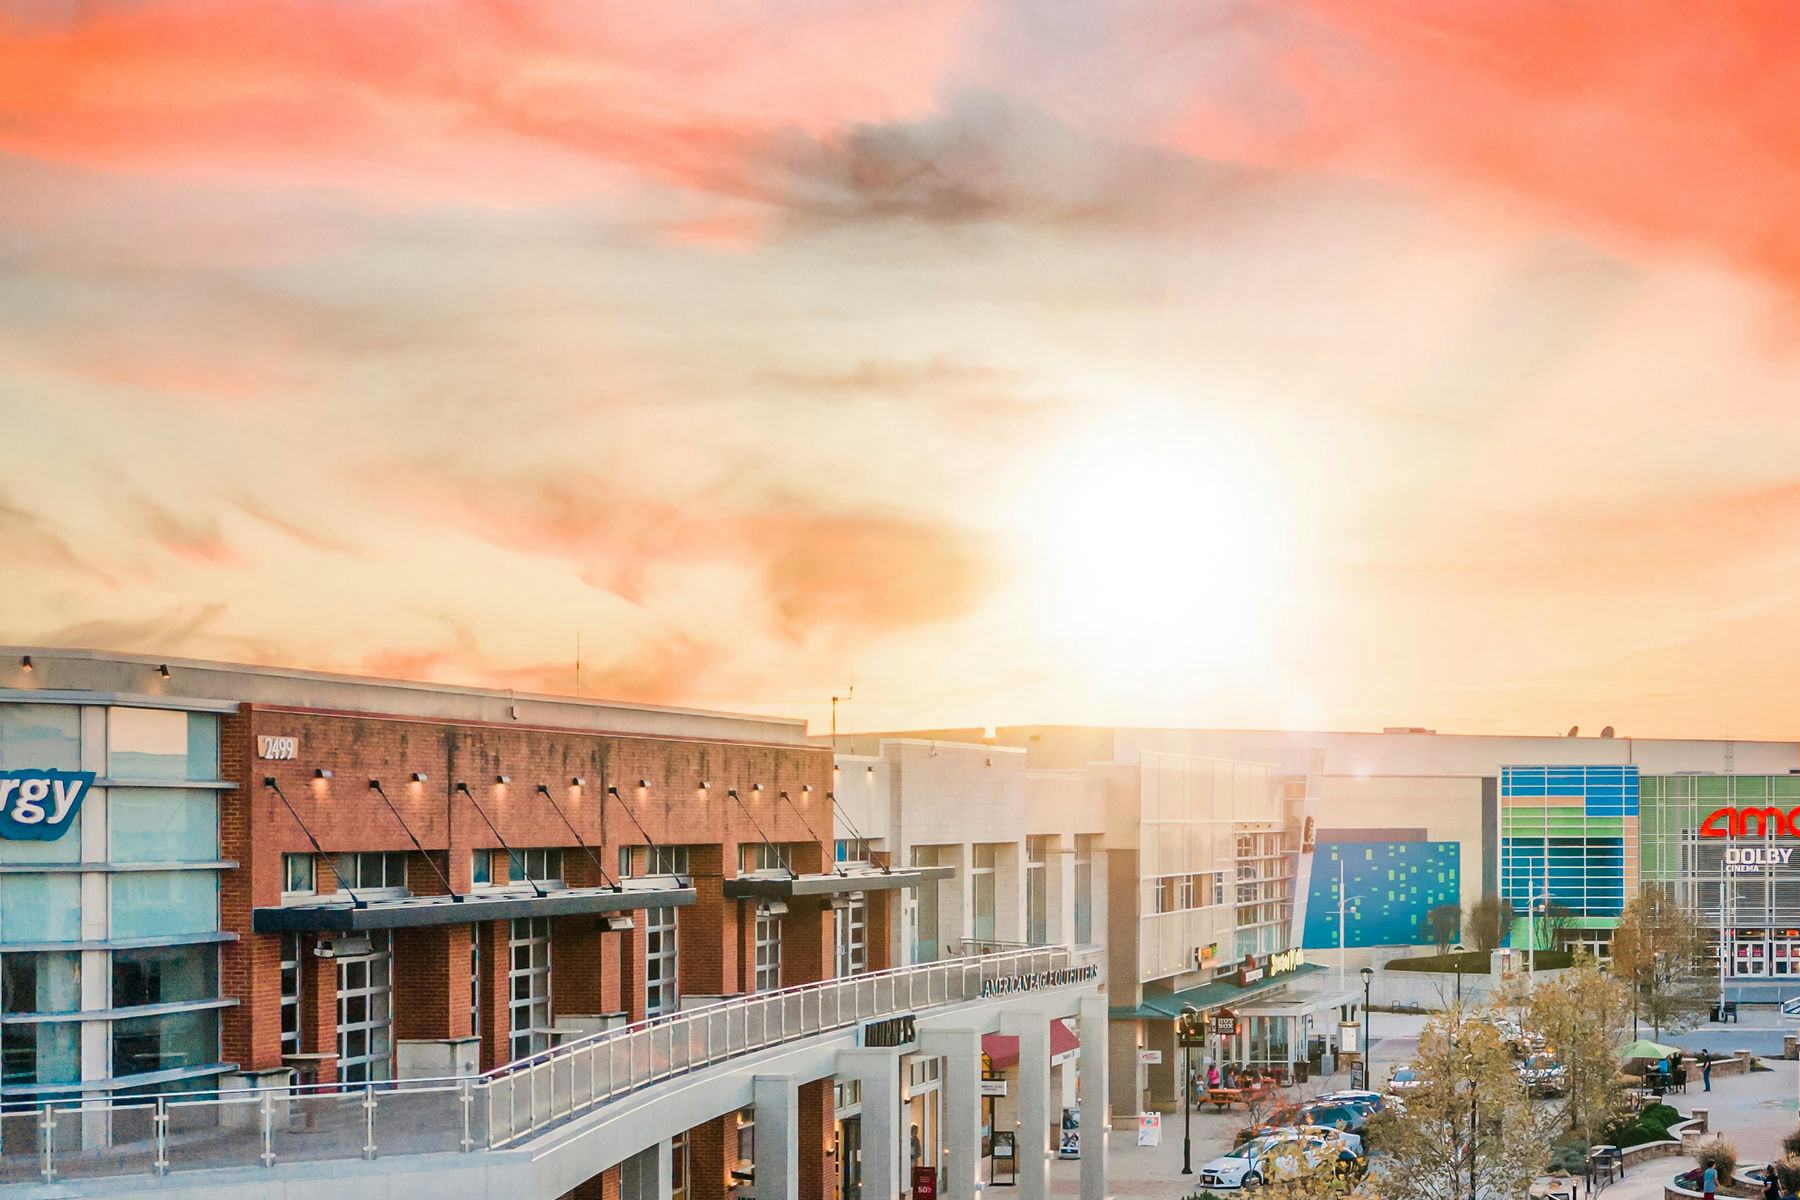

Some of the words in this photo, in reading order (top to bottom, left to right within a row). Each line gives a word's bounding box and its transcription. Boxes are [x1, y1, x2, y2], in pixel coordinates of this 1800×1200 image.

[265, 737, 294, 760] 2499
[1726, 849, 1793, 864] DOLBY
[983, 975, 1031, 998] AMERICAN
